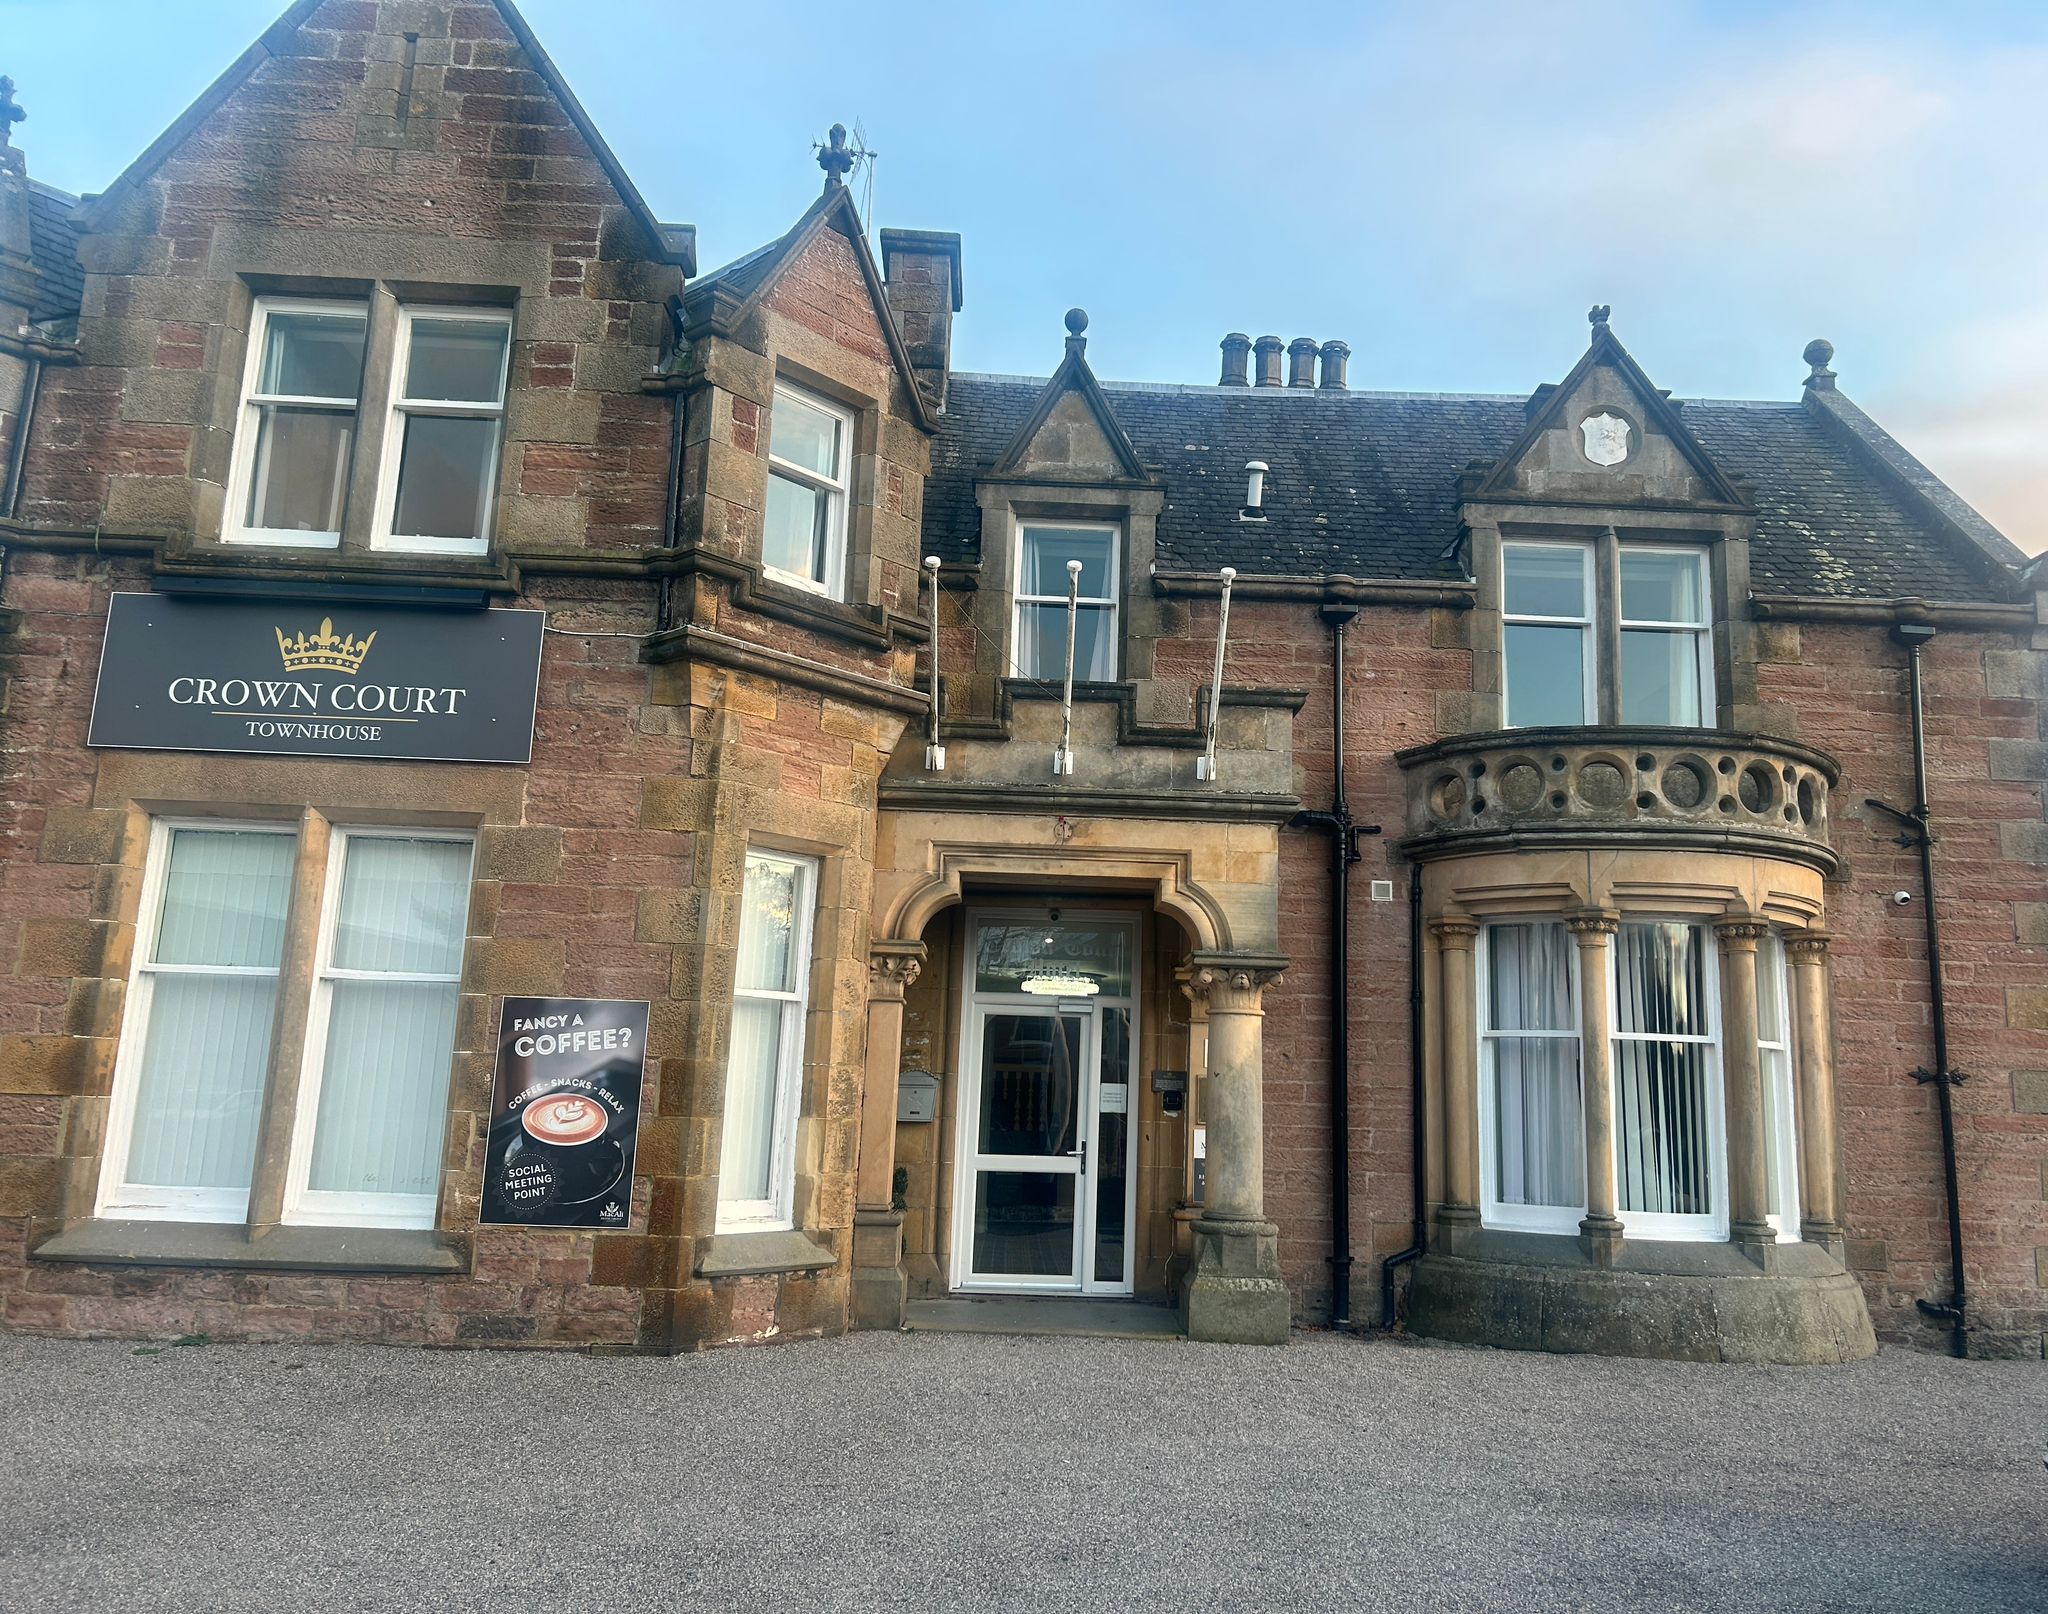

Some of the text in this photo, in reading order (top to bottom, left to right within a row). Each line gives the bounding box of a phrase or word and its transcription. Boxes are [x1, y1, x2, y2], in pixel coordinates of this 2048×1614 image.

[168, 677, 467, 714] CROWN COURT
[245, 721, 382, 741] TOWNHOUSE
[514, 1013, 584, 1031] FANCY A
[514, 1027, 632, 1057] COFFEE?
[508, 1083, 544, 1110] COFFEE
[551, 1078, 593, 1090] SNACKS
[598, 1088, 625, 1114] RELAX
[508, 1163, 547, 1178] SOCIAL
[505, 1174, 552, 1190] MEETING
[514, 1186, 546, 1200] POINT
